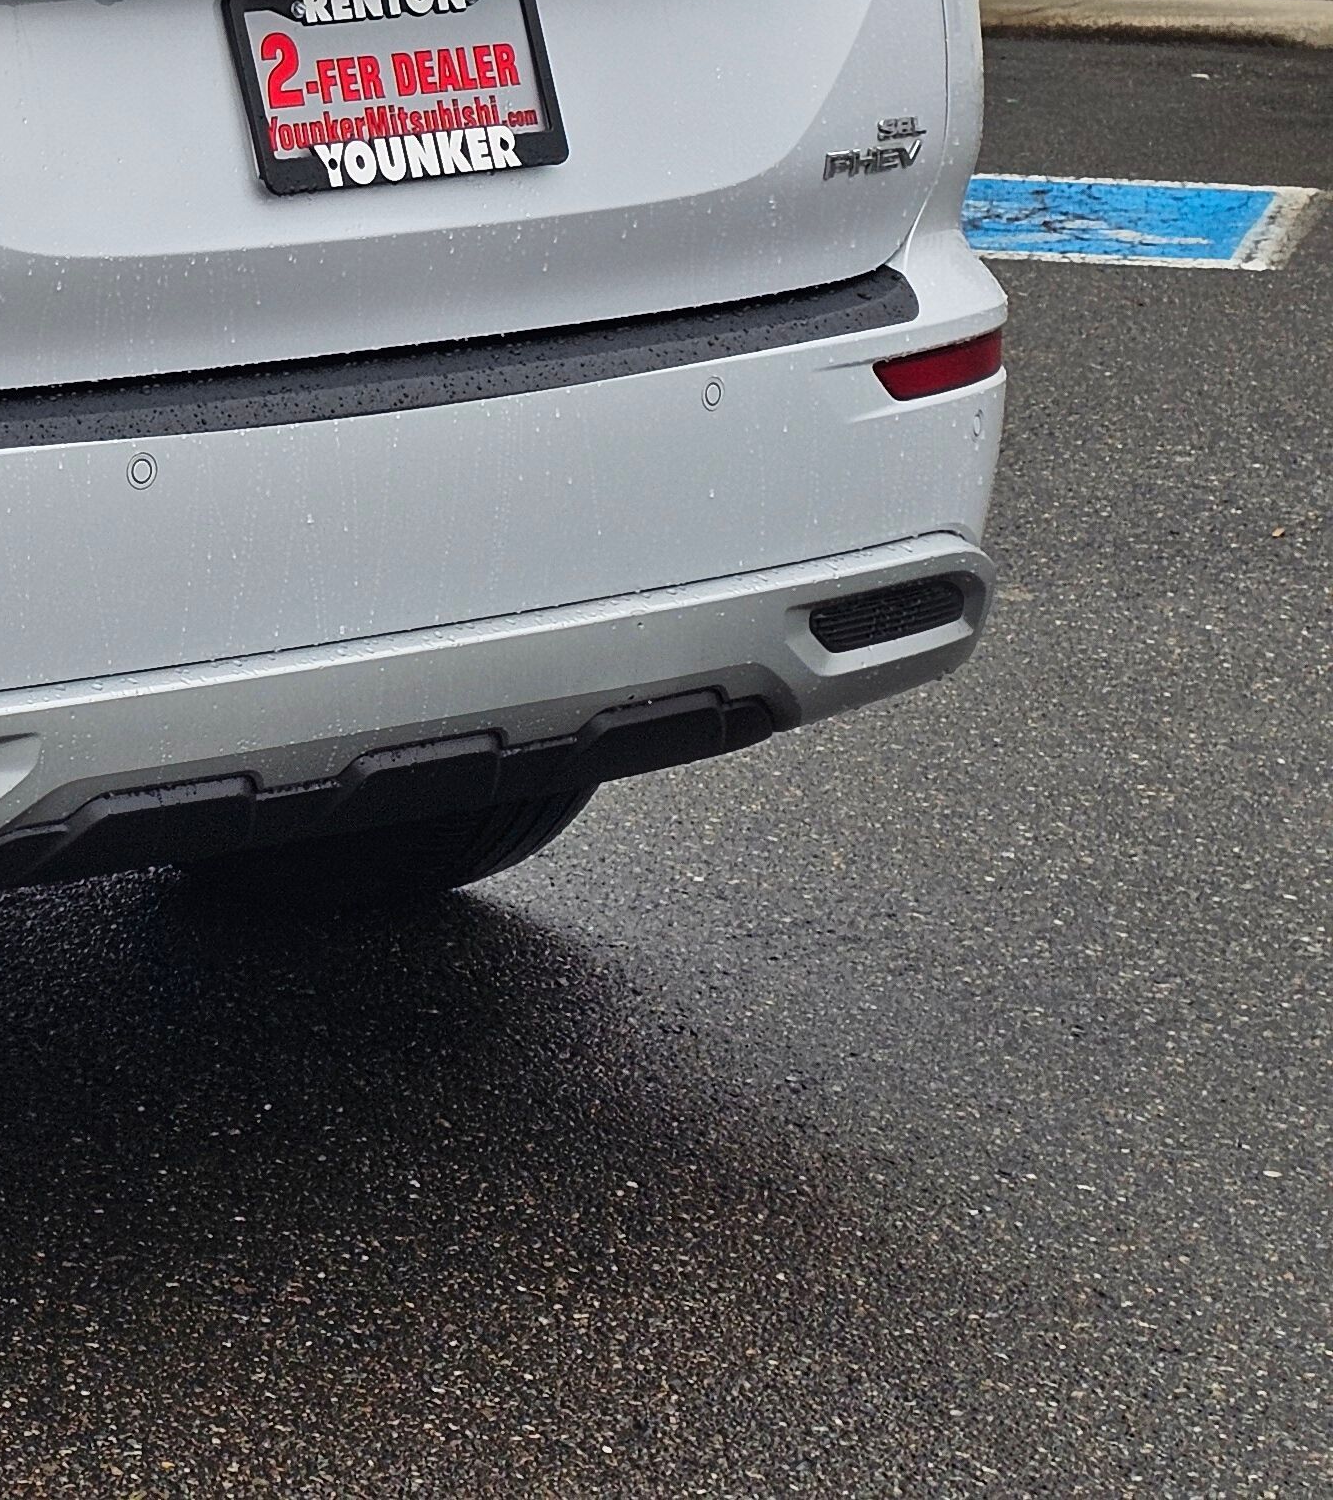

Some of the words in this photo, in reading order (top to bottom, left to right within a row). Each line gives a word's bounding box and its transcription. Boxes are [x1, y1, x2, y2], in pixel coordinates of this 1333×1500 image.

[261, 32, 386, 109] 2-FER
[391, 43, 521, 97] DEALER
[268, 96, 538, 152] YounkerMitsubishi.com
[313, 125, 523, 188] YOUNKER
[823, 140, 922, 181] PHEV
